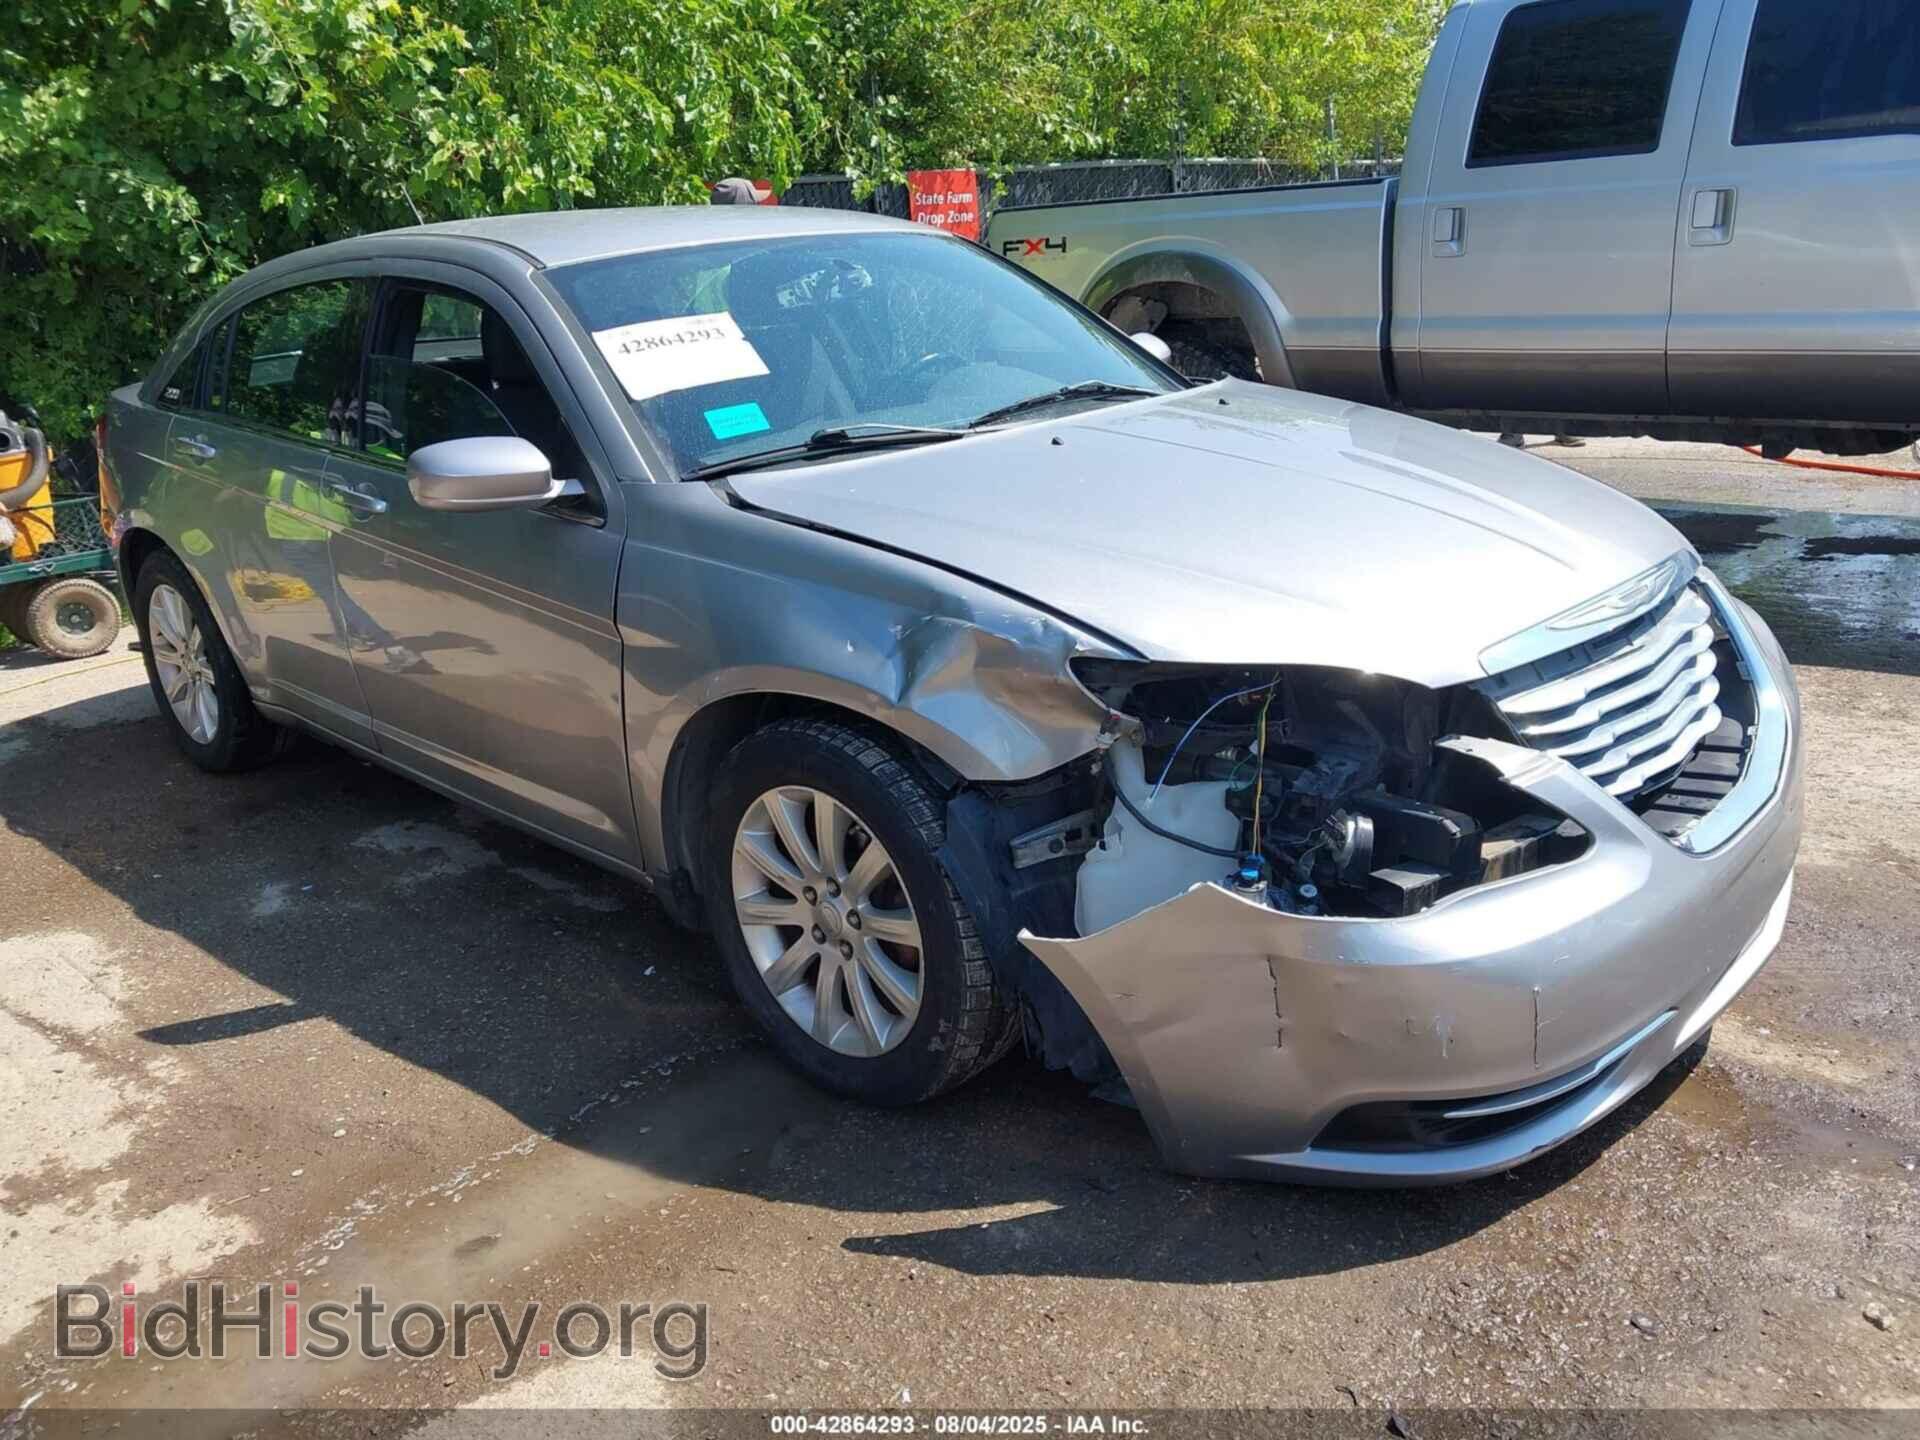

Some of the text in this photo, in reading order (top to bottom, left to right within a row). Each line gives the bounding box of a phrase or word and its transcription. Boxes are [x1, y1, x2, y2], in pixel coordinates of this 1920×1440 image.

[915, 191, 973, 205] State Farm
[917, 210, 974, 226] Drop Zone
[1003, 236, 1067, 256] FX4
[618, 327, 726, 355] 42864293
